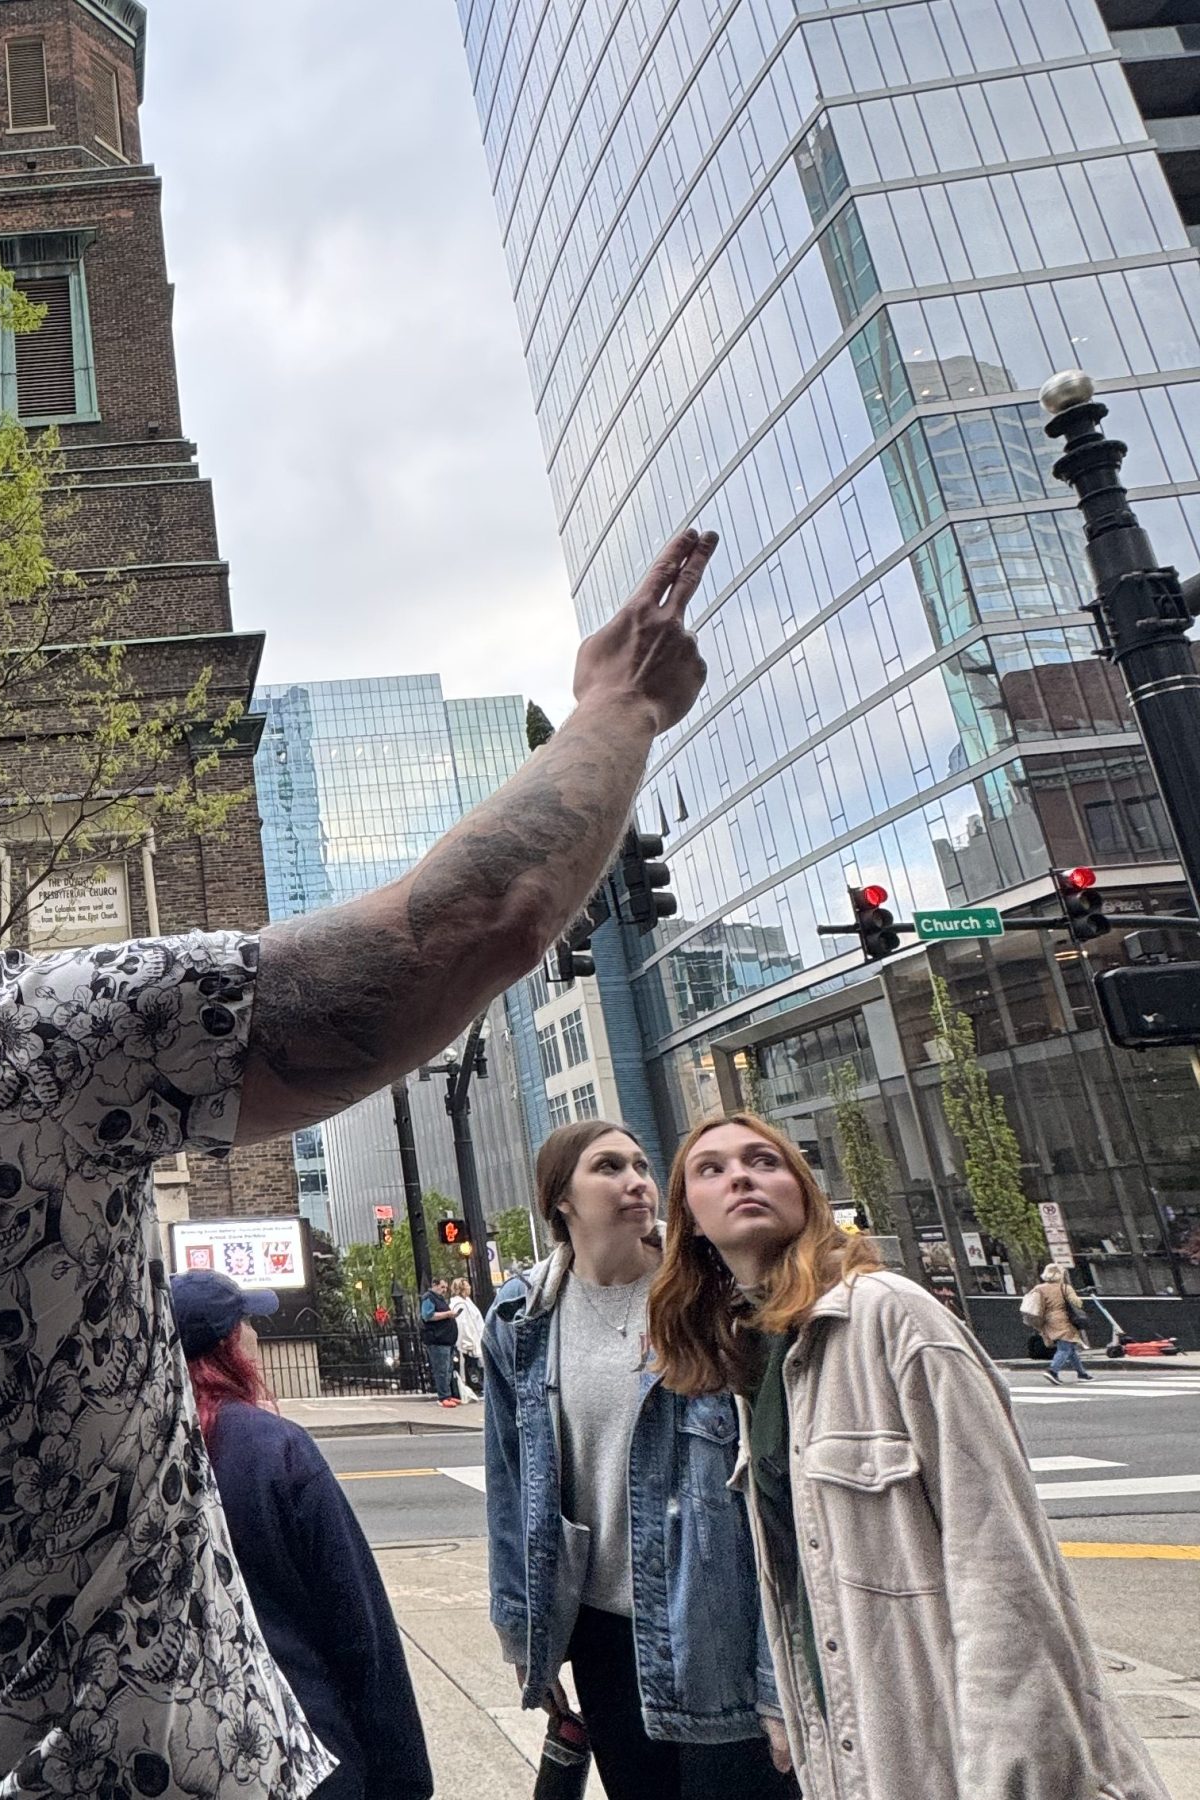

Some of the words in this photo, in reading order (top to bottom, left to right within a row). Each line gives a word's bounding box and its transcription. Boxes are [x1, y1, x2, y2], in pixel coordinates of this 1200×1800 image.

[48, 878, 61, 887] THE
[89, 886, 118, 897] CHURCH
[921, 916, 981, 932] Church
[986, 918, 997, 929] St
